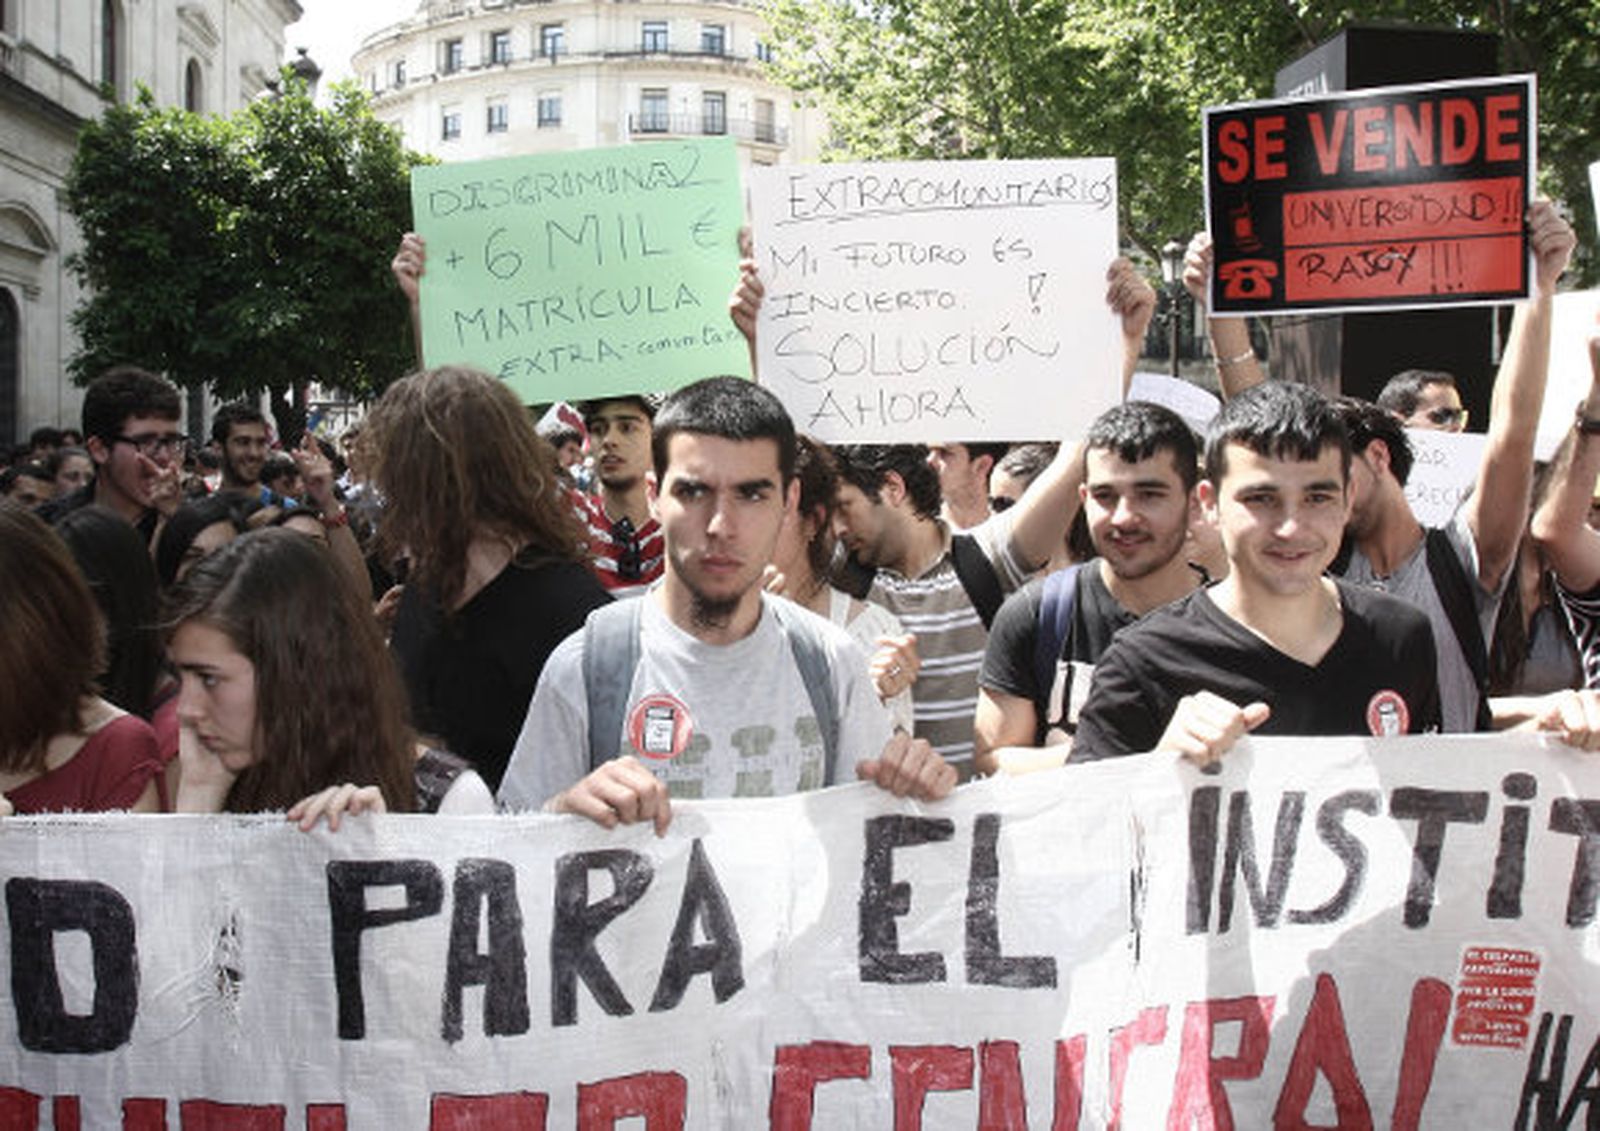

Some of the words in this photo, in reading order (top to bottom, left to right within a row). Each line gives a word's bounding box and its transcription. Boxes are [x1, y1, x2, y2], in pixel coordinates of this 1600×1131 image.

[1217, 115, 1288, 184] SE
[1308, 94, 1521, 176] VENDE
[485, 227, 522, 280] 6
[546, 213, 669, 271] MIL
[690, 208, 719, 247] €
[833, 242, 966, 268] FUTURO
[775, 323, 1060, 384] SOLUCIÓN
[325, 837, 745, 1044] PARA
[858, 812, 1060, 989] EL
